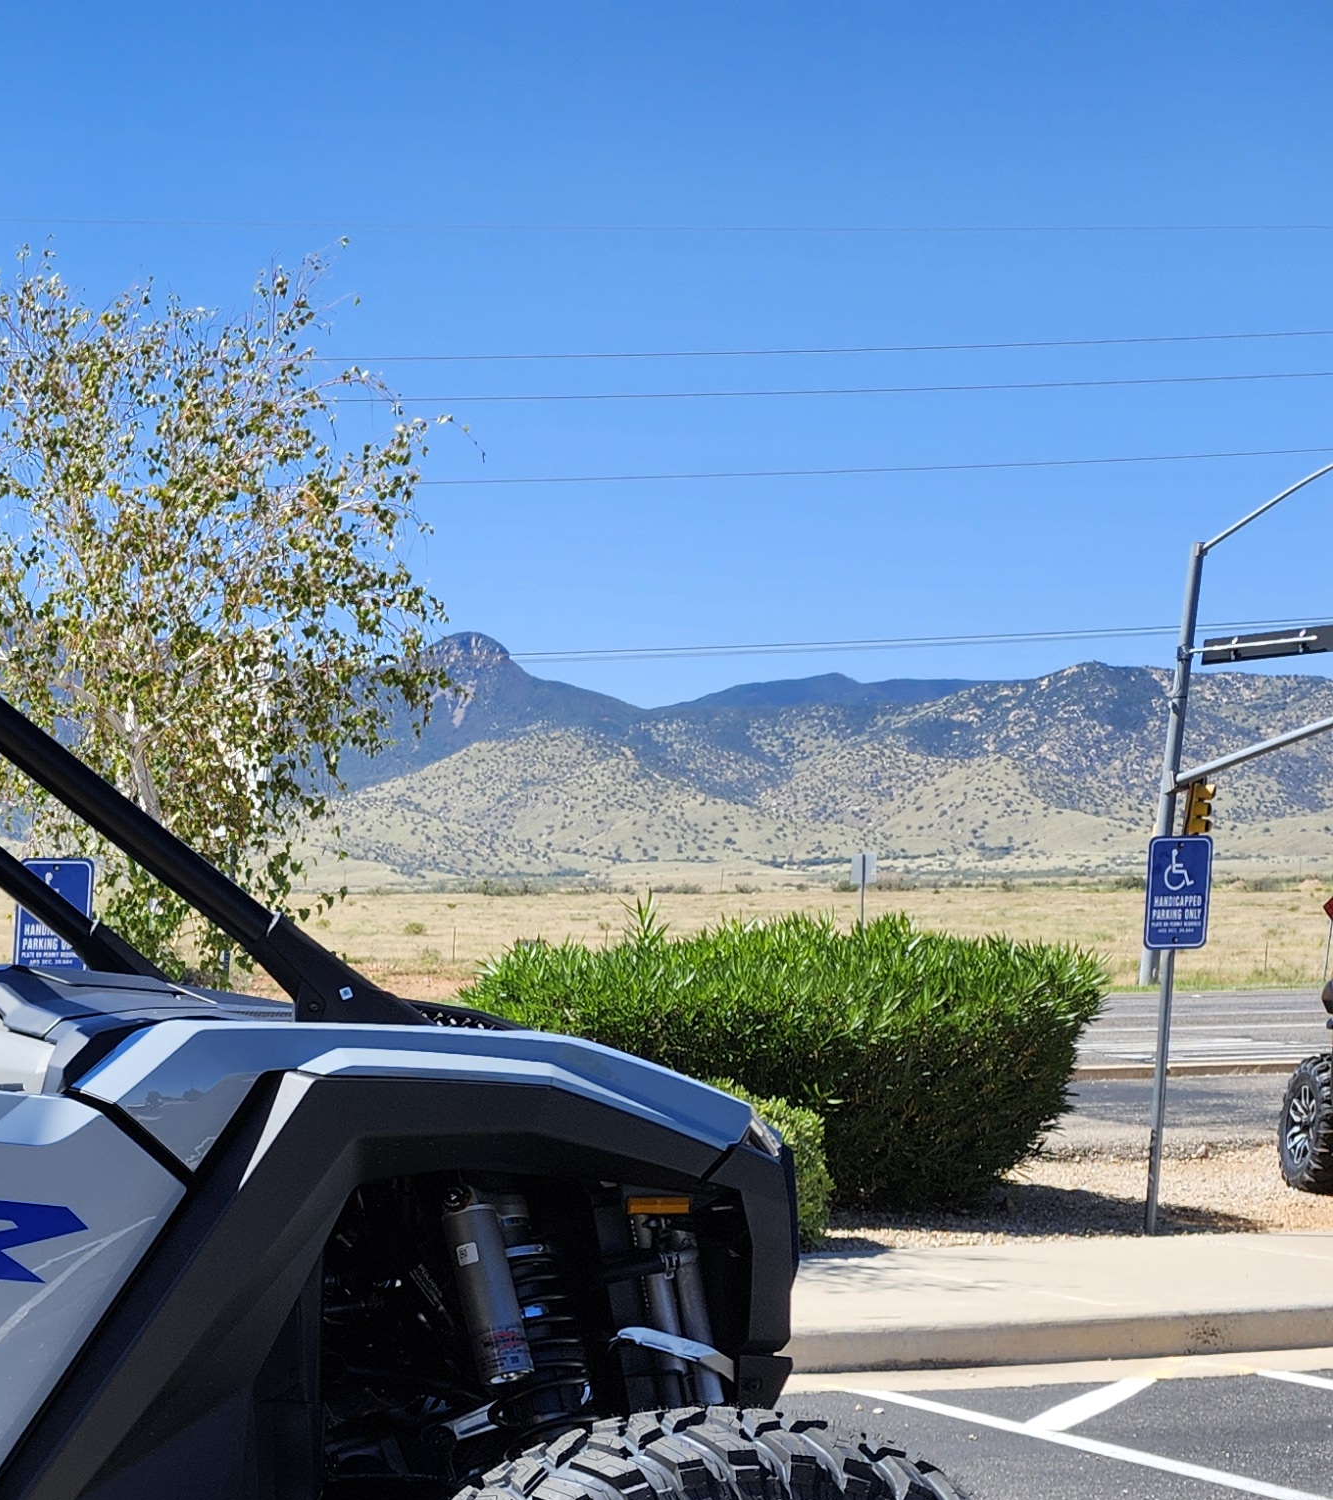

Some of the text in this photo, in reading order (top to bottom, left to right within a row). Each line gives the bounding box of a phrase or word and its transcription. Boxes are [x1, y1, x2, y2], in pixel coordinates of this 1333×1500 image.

[1153, 895, 1202, 907] HANDICAPPED
[1152, 908, 1202, 920] PARKING ONLY
[22, 937, 58, 950] PARKING
